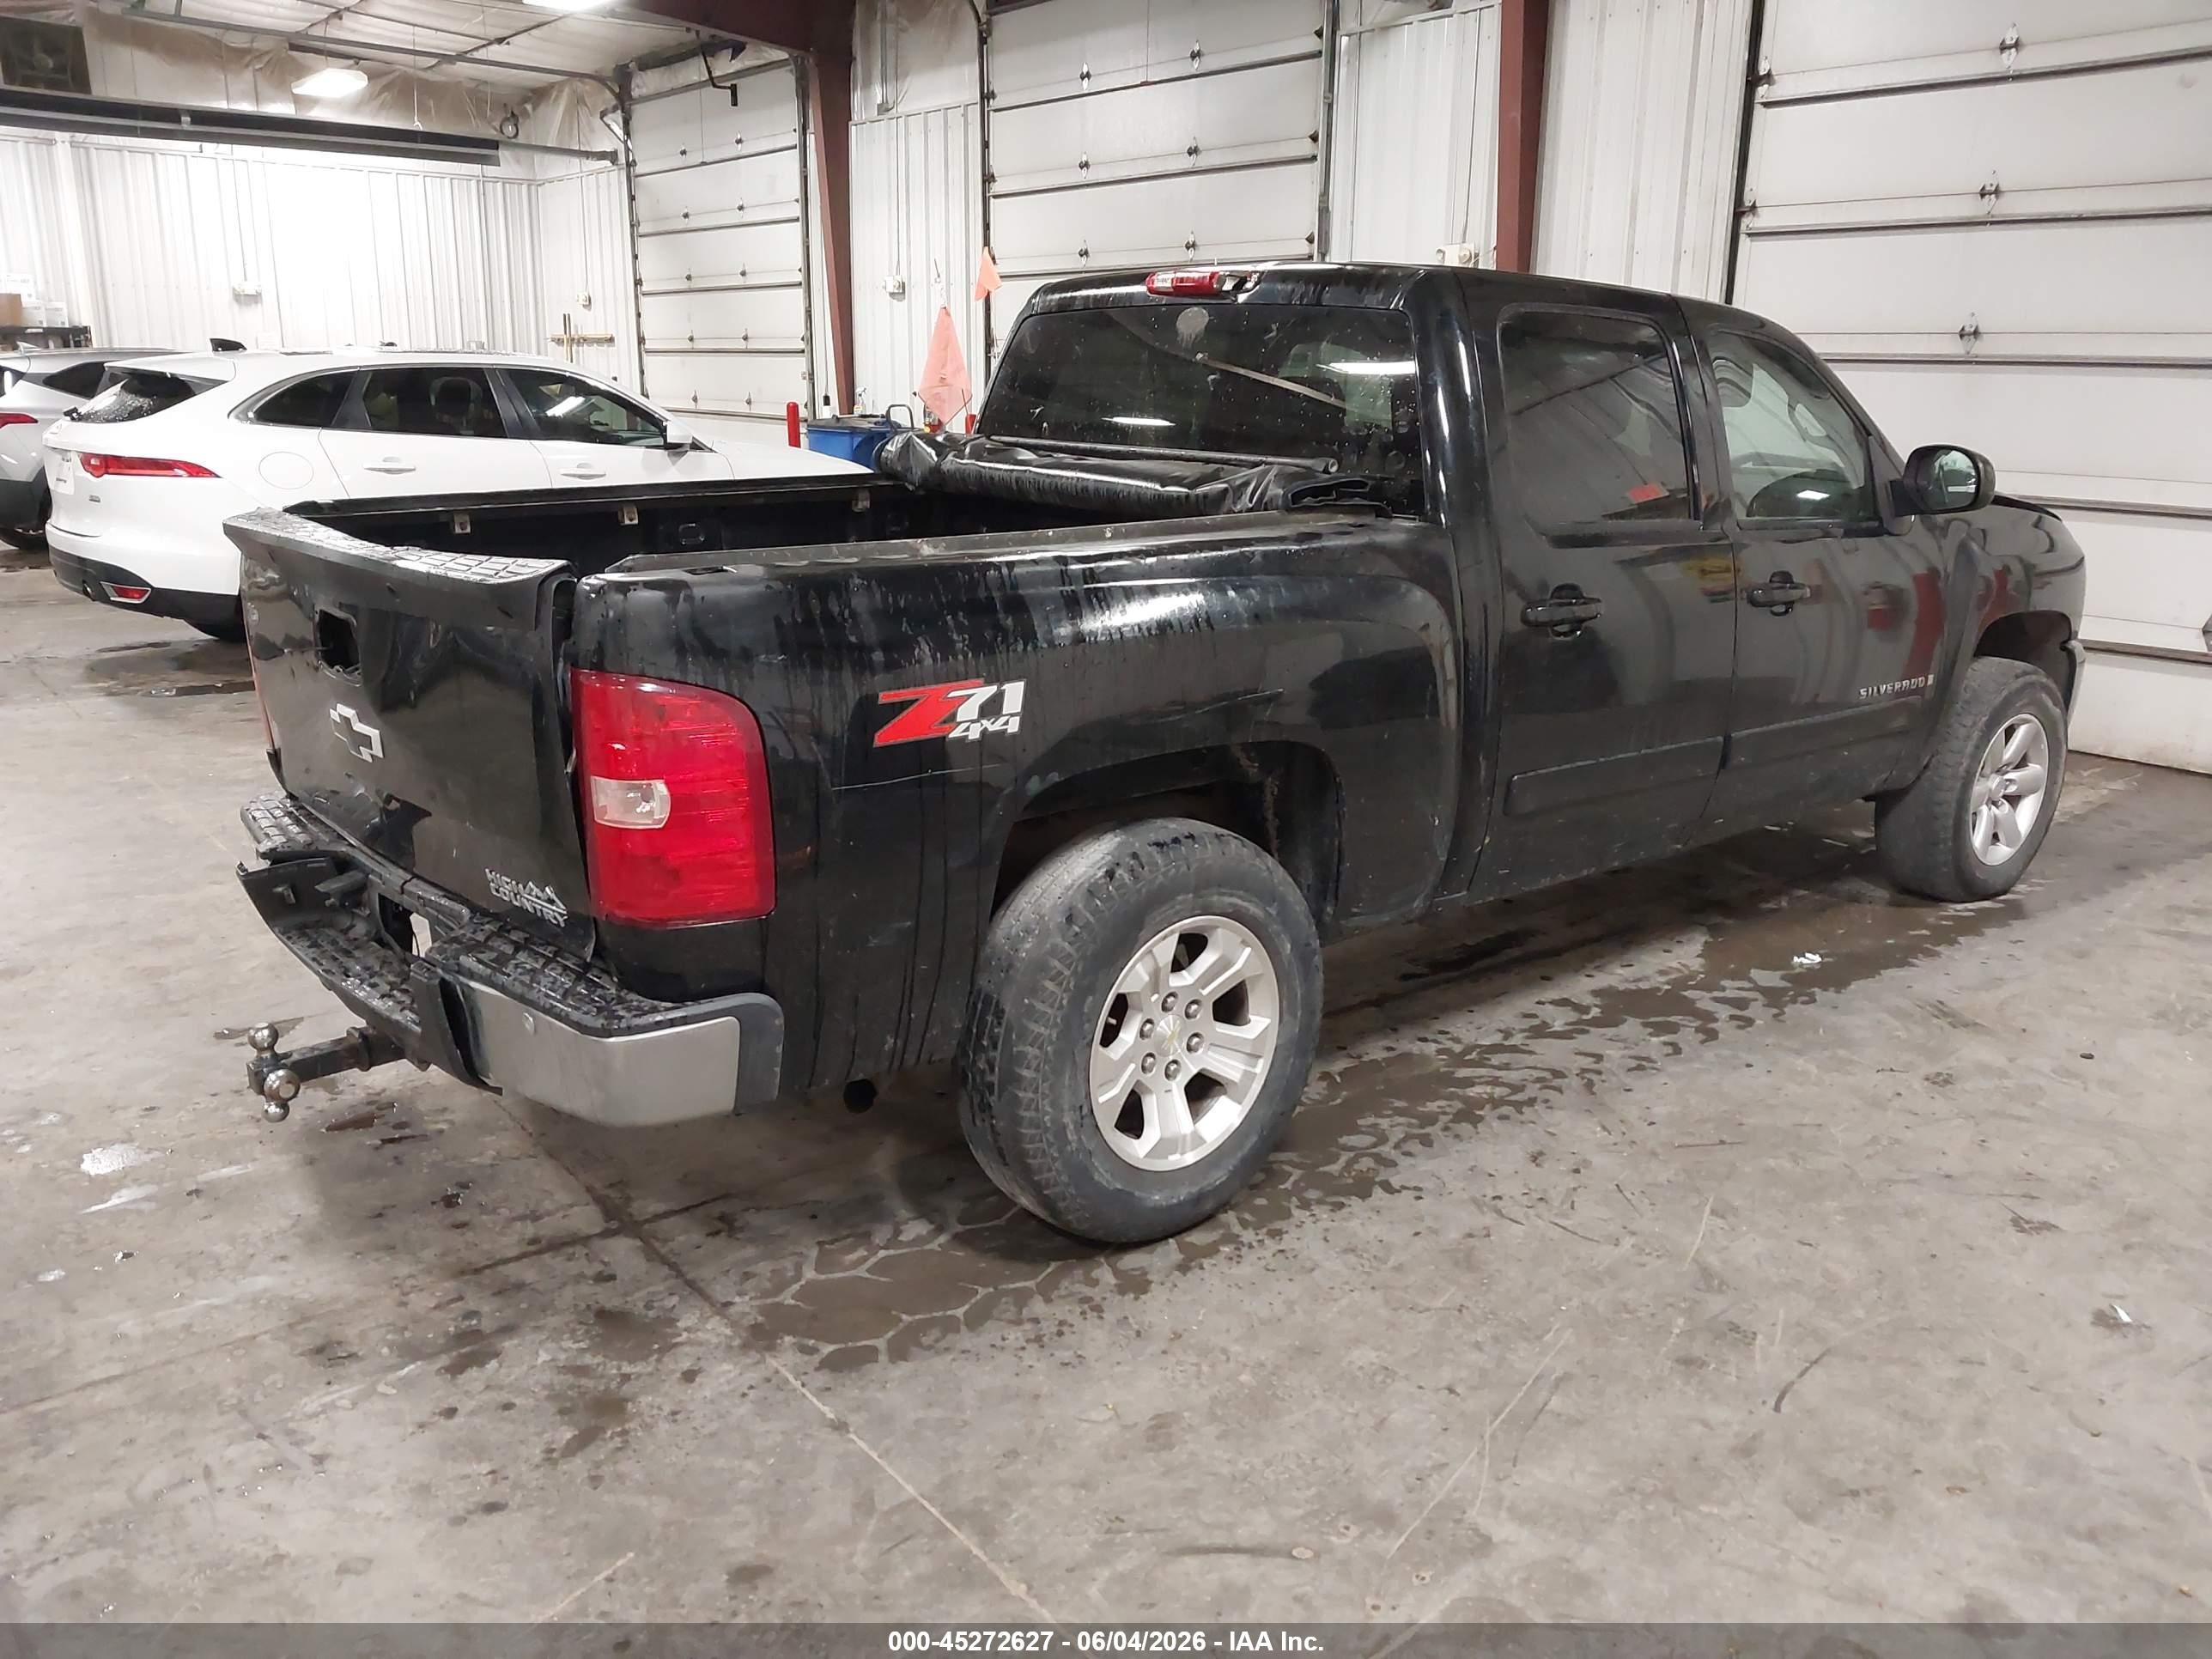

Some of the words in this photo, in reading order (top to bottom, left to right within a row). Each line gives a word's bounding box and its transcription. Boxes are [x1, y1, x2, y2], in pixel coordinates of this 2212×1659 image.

[1859, 676, 1925, 699] SILVERADO
[872, 678, 1027, 748] Z71
[484, 867, 526, 895] HIGH
[489, 882, 568, 928] COUNTRY
